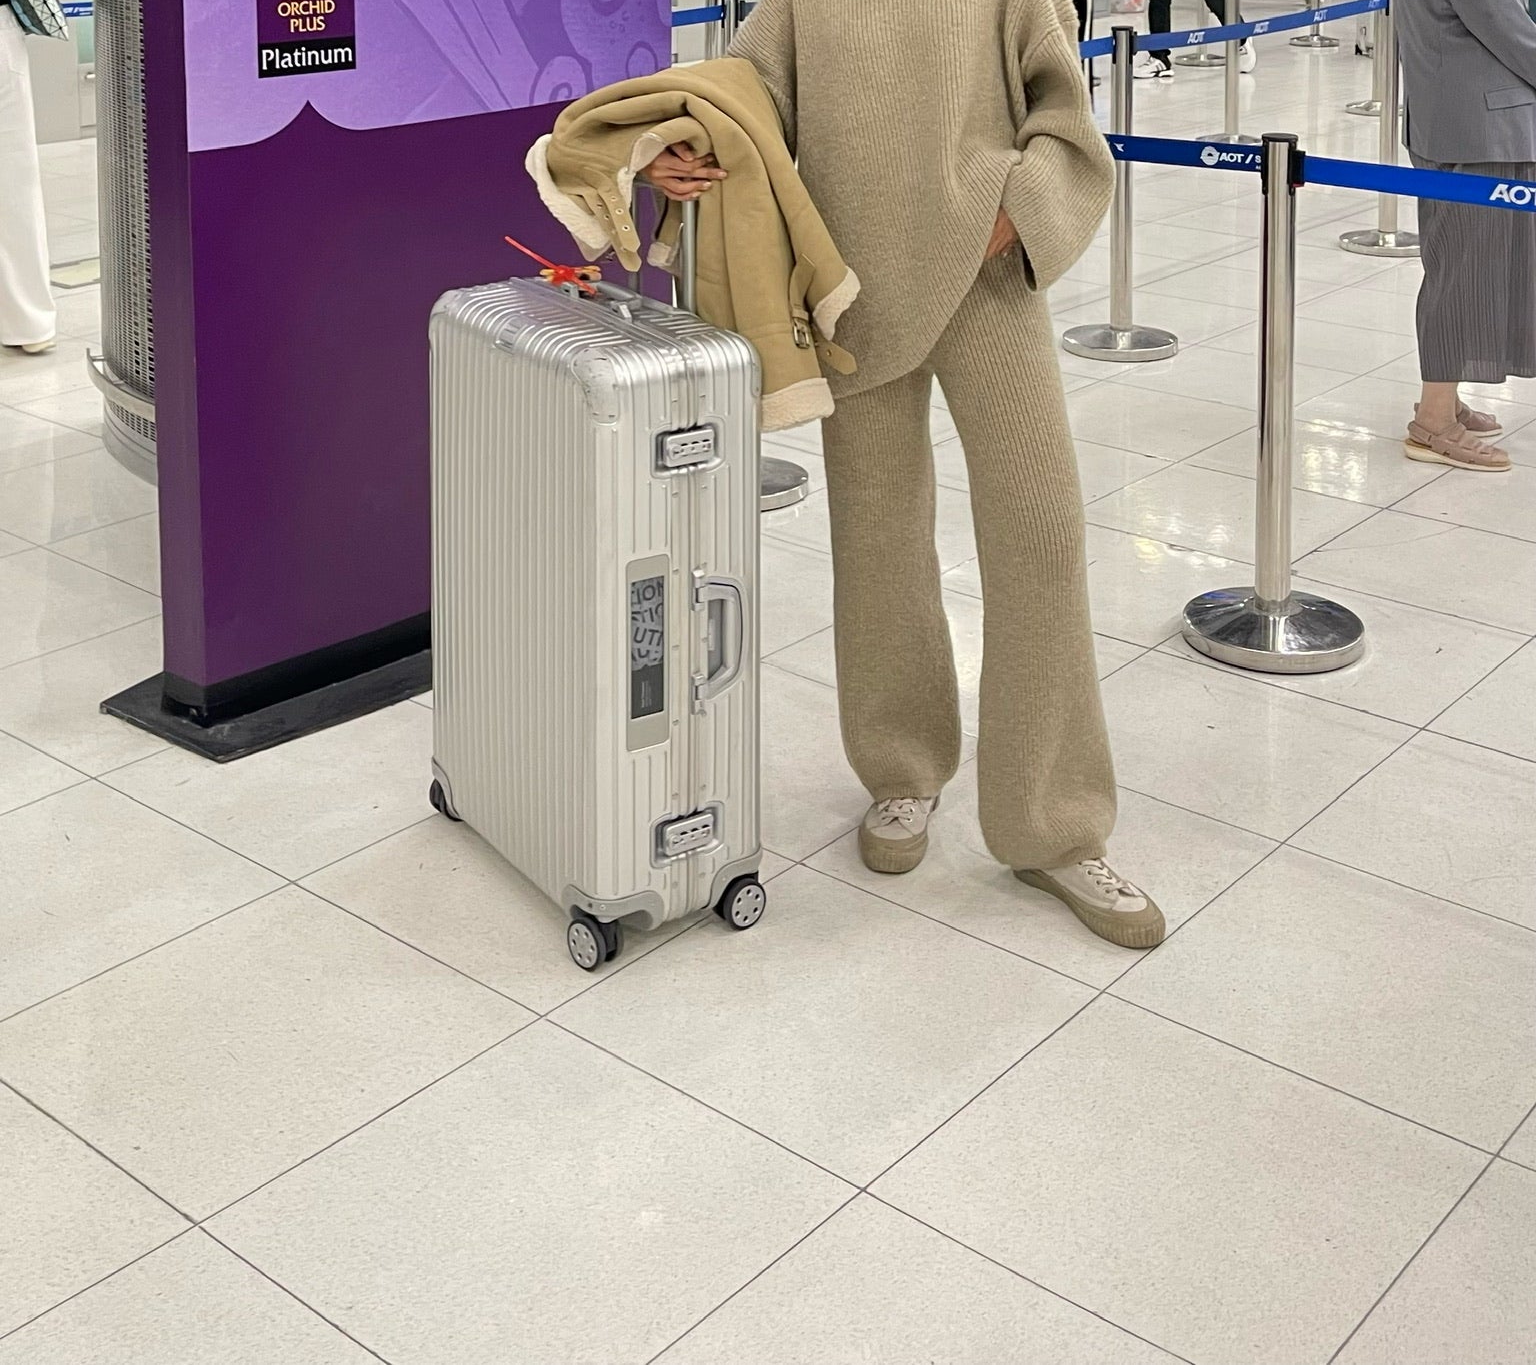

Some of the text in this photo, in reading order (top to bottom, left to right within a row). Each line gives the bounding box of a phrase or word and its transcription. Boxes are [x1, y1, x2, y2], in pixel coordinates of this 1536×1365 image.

[277, 0, 336, 17] ORCHID
[290, 16, 326, 33] PLUS
[1187, 31, 1205, 44] AOT
[261, 46, 353, 70] Platinum
[1219, 152, 1245, 163] AOT
[1255, 155, 1262, 164] S
